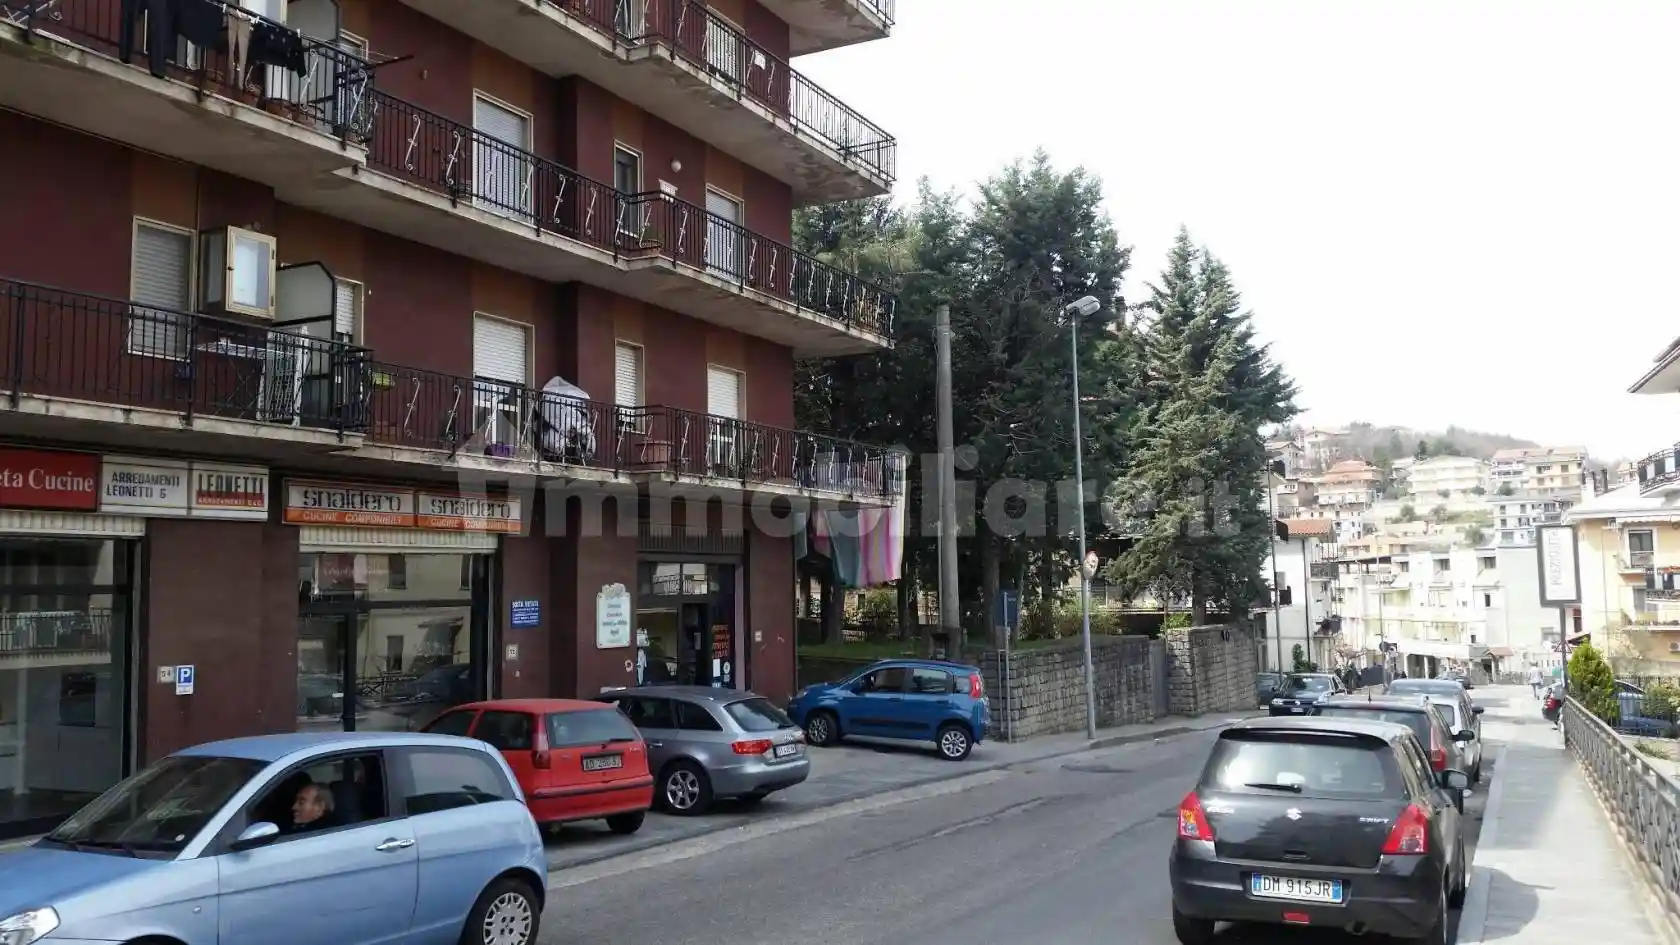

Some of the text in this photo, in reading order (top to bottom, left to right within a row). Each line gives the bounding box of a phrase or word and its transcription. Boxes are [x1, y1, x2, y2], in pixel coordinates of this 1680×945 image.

[29, 468, 93, 491] Cucine
[112, 472, 180, 487] ARREDAMENTI
[198, 474, 264, 498] LEONETTI
[106, 484, 153, 498] LEONETTI
[303, 511, 337, 521] CUCINE
[1263, 876, 1280, 892] DM
